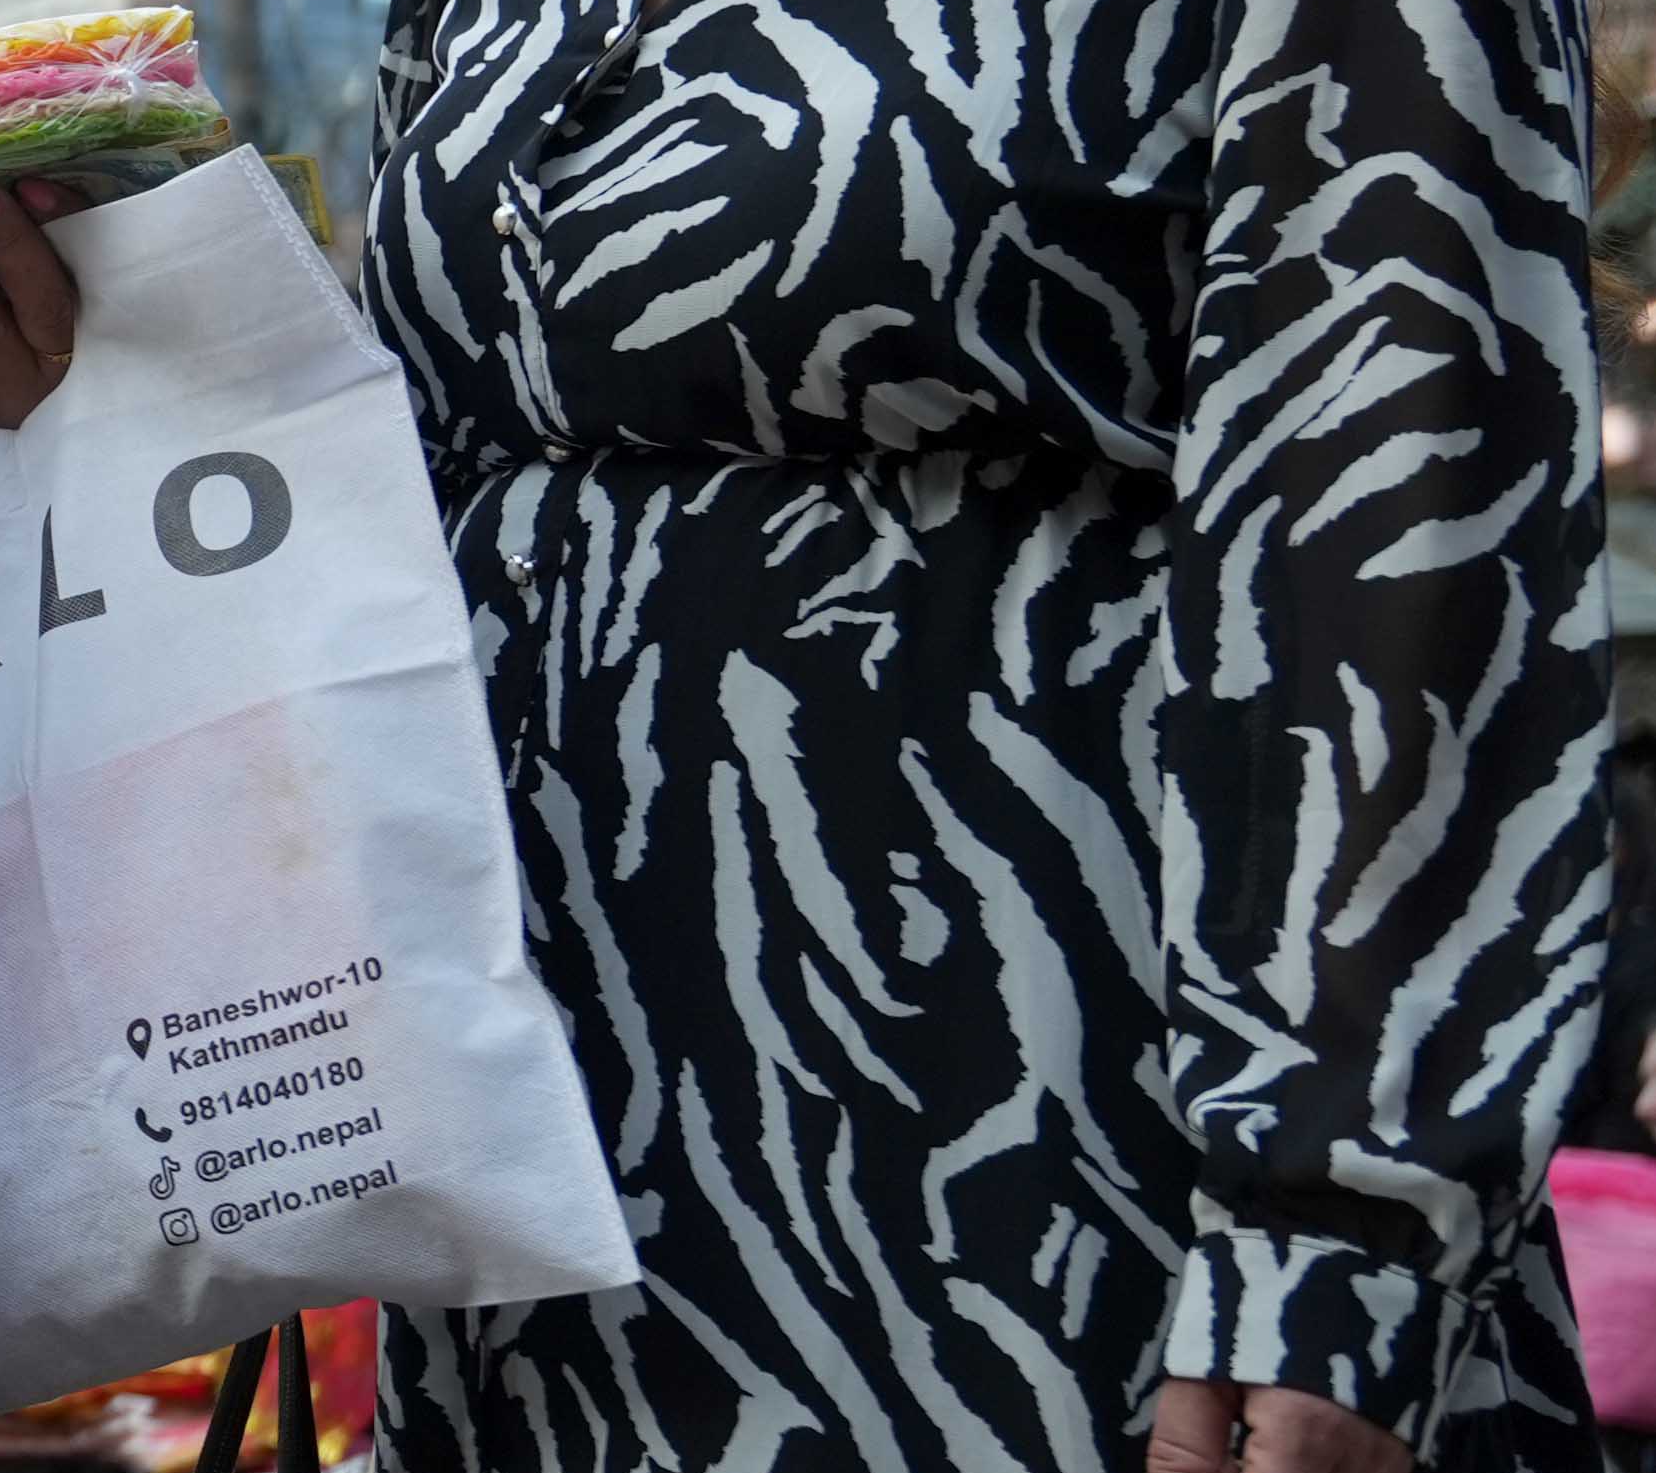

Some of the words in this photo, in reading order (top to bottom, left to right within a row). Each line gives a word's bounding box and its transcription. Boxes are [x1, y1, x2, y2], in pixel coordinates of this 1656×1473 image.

[161, 956, 383, 1039] Baneshwor-10
[168, 1009, 350, 1075] Kathmandu
[179, 1056, 364, 1126] 9814040180
[194, 1106, 383, 1183] @arlo.nepal
[209, 1159, 399, 1235] @arlo.nepal
